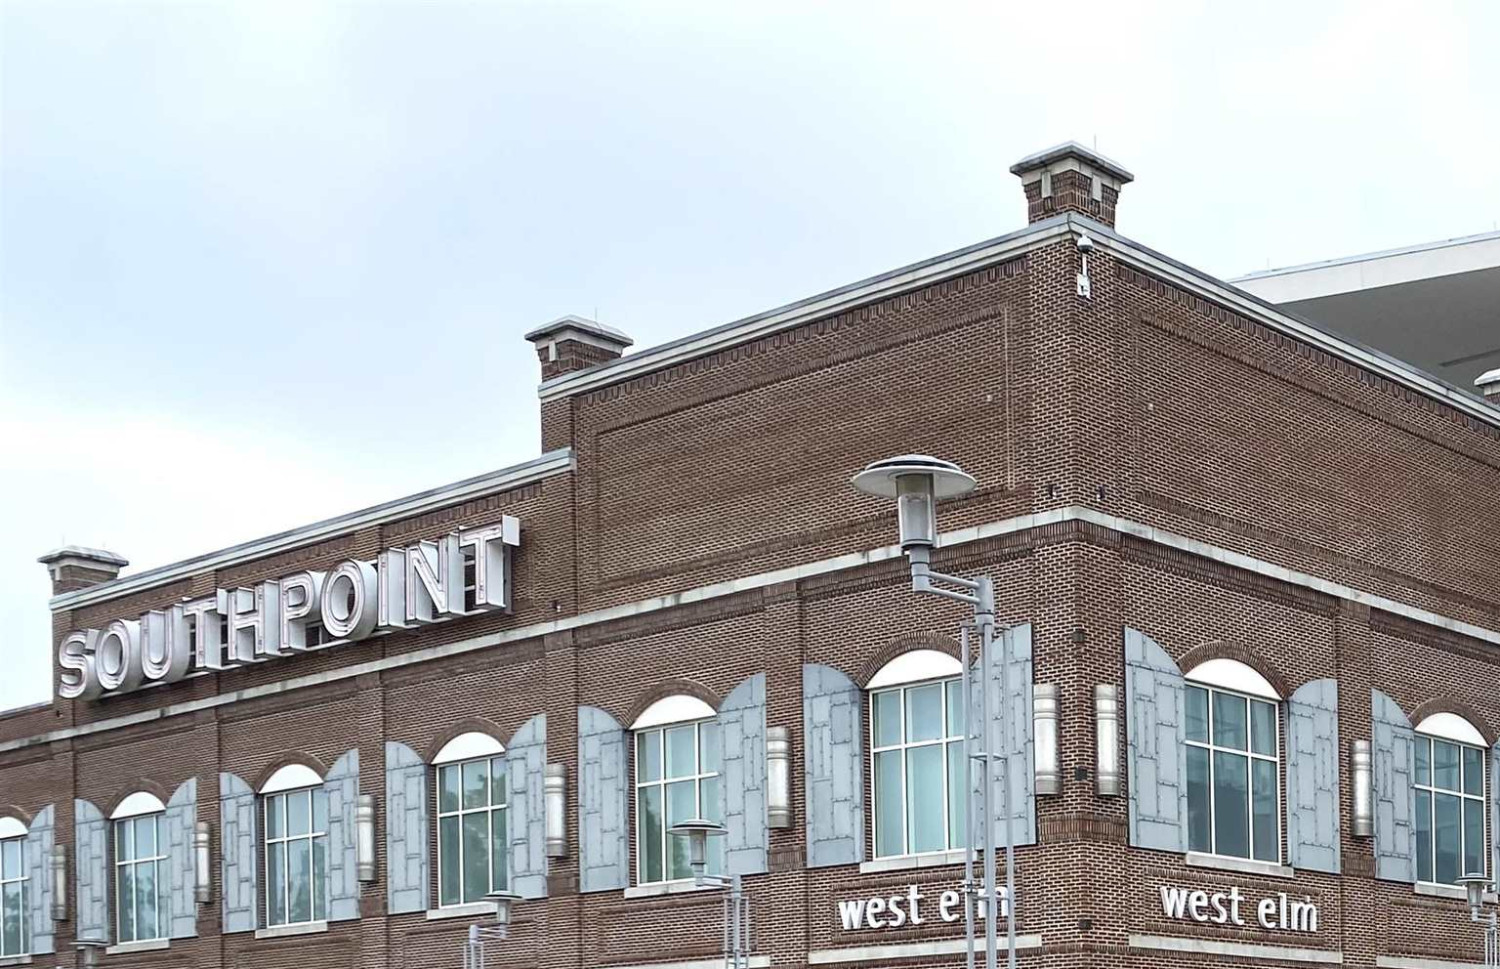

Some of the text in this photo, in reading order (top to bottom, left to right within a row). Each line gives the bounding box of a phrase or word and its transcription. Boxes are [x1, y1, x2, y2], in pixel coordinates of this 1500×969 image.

[59, 516, 519, 699] SOUTHPOINT
[838, 882, 1009, 930] west em
[1160, 886, 1317, 932] west elm
